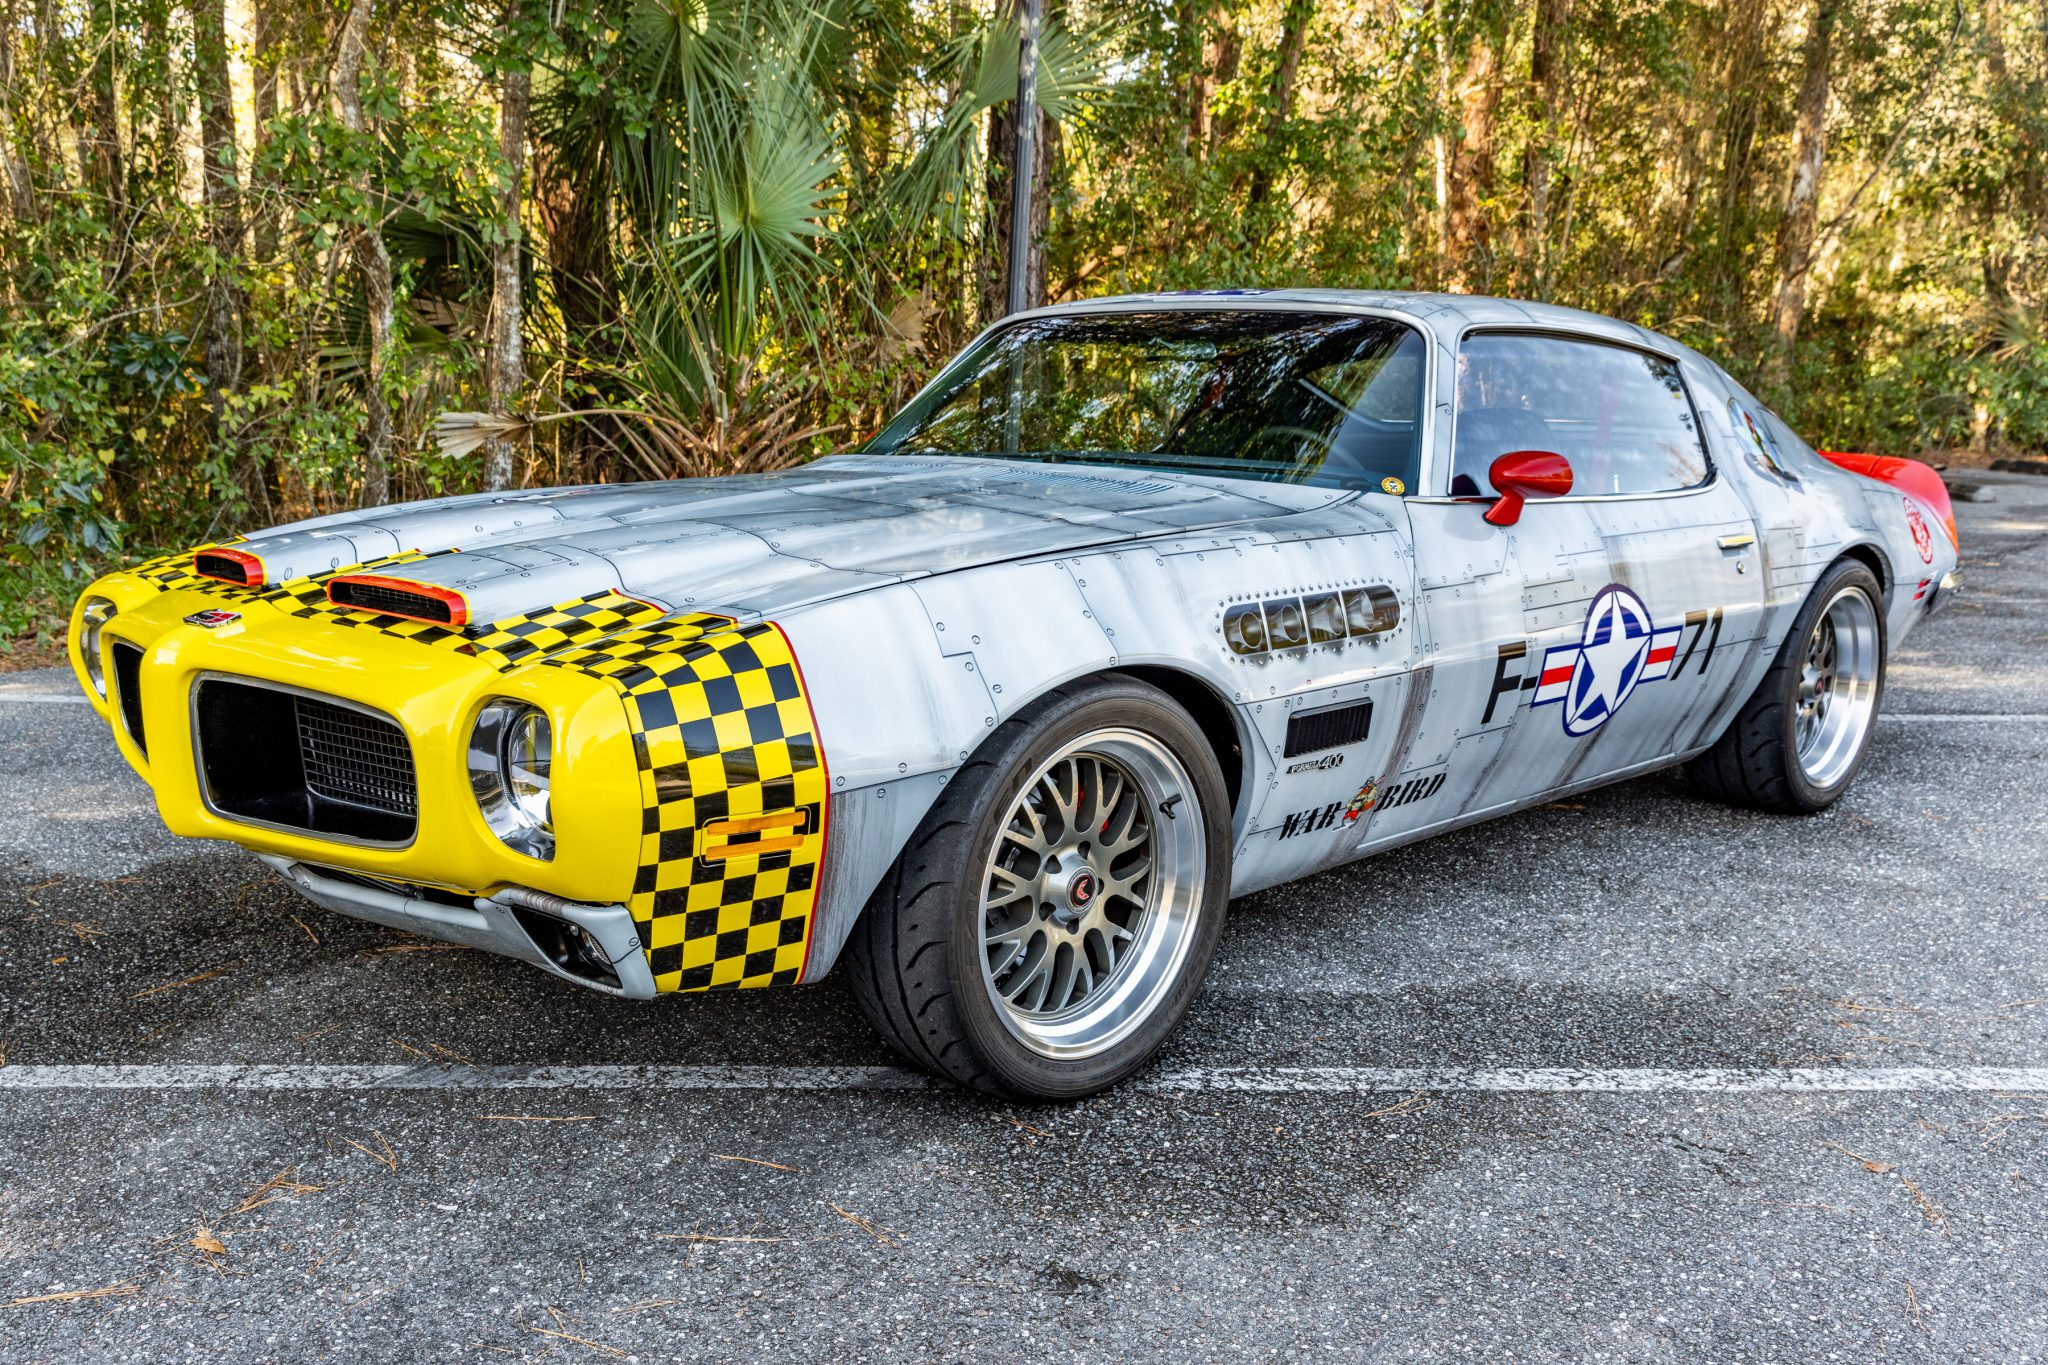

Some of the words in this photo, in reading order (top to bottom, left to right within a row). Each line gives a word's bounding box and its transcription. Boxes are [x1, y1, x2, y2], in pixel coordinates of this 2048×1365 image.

[1670, 607, 1723, 680] 71
[1321, 753, 1345, 770] 400
[1279, 801, 1342, 840] WAR
[1373, 773, 1447, 812] BIRD
